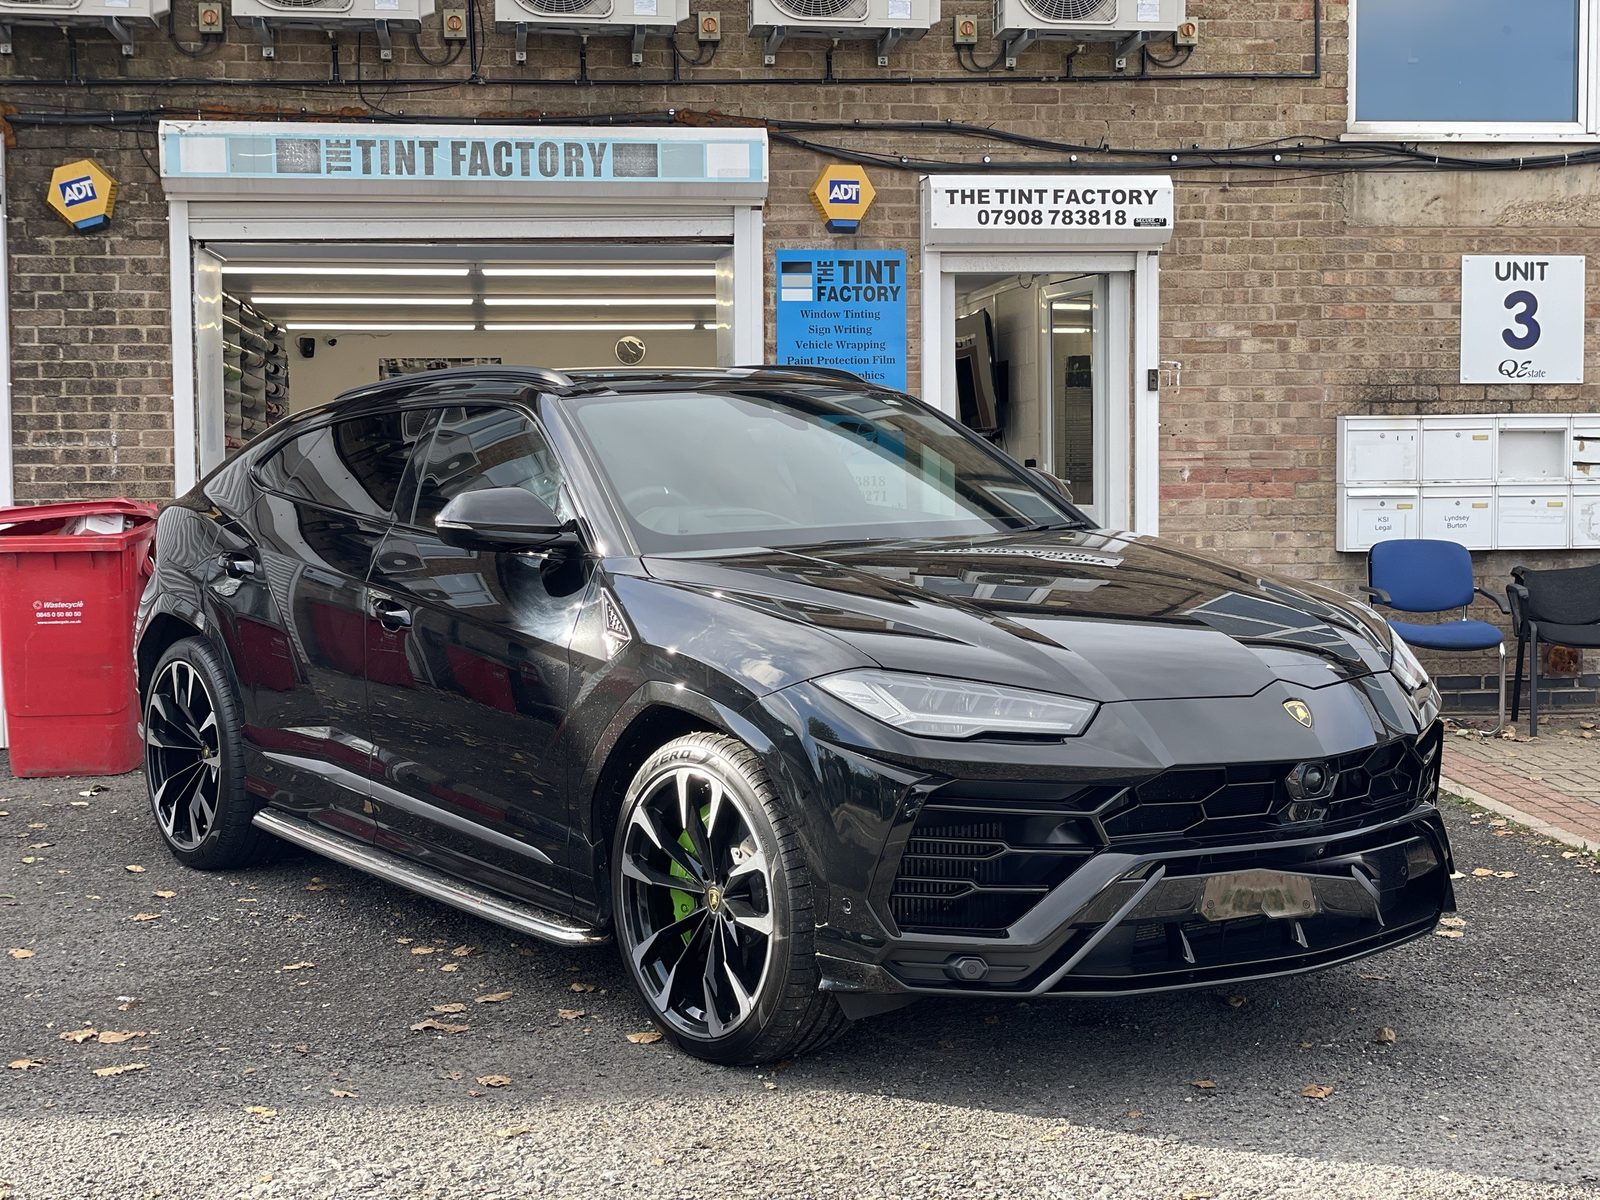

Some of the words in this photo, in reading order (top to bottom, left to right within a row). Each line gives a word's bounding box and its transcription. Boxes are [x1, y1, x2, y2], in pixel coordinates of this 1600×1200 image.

[325, 138, 352, 175] THE
[356, 138, 439, 176] TINT
[450, 140, 607, 178] FACTORY
[64, 179, 92, 204] ADT
[829, 183, 860, 201] ADT
[945, 189, 990, 205] THE
[995, 189, 1048, 205] TINT
[1053, 189, 1158, 205] FACTORY
[977, 209, 1043, 226] 07908
[1048, 209, 1127, 226] 783818
[817, 260, 834, 284] THE
[838, 259, 900, 284] TINT
[1495, 261, 1549, 281] UNIT
[816, 285, 901, 302] FACTORY
[800, 309, 841, 319] Window
[843, 309, 881, 320] Tinting
[1502, 290, 1540, 350] 3
[808, 325, 831, 336] Sign
[833, 325, 873, 336] Writing
[795, 340, 833, 350] Vehicle
[836, 340, 886, 352] Wrapping
[787, 356, 814, 366] Paint
[817, 355, 869, 365] Protection
[873, 355, 896, 365] Film
[858, 371, 885, 380] phics
[651, 750, 692, 771] ZERO
